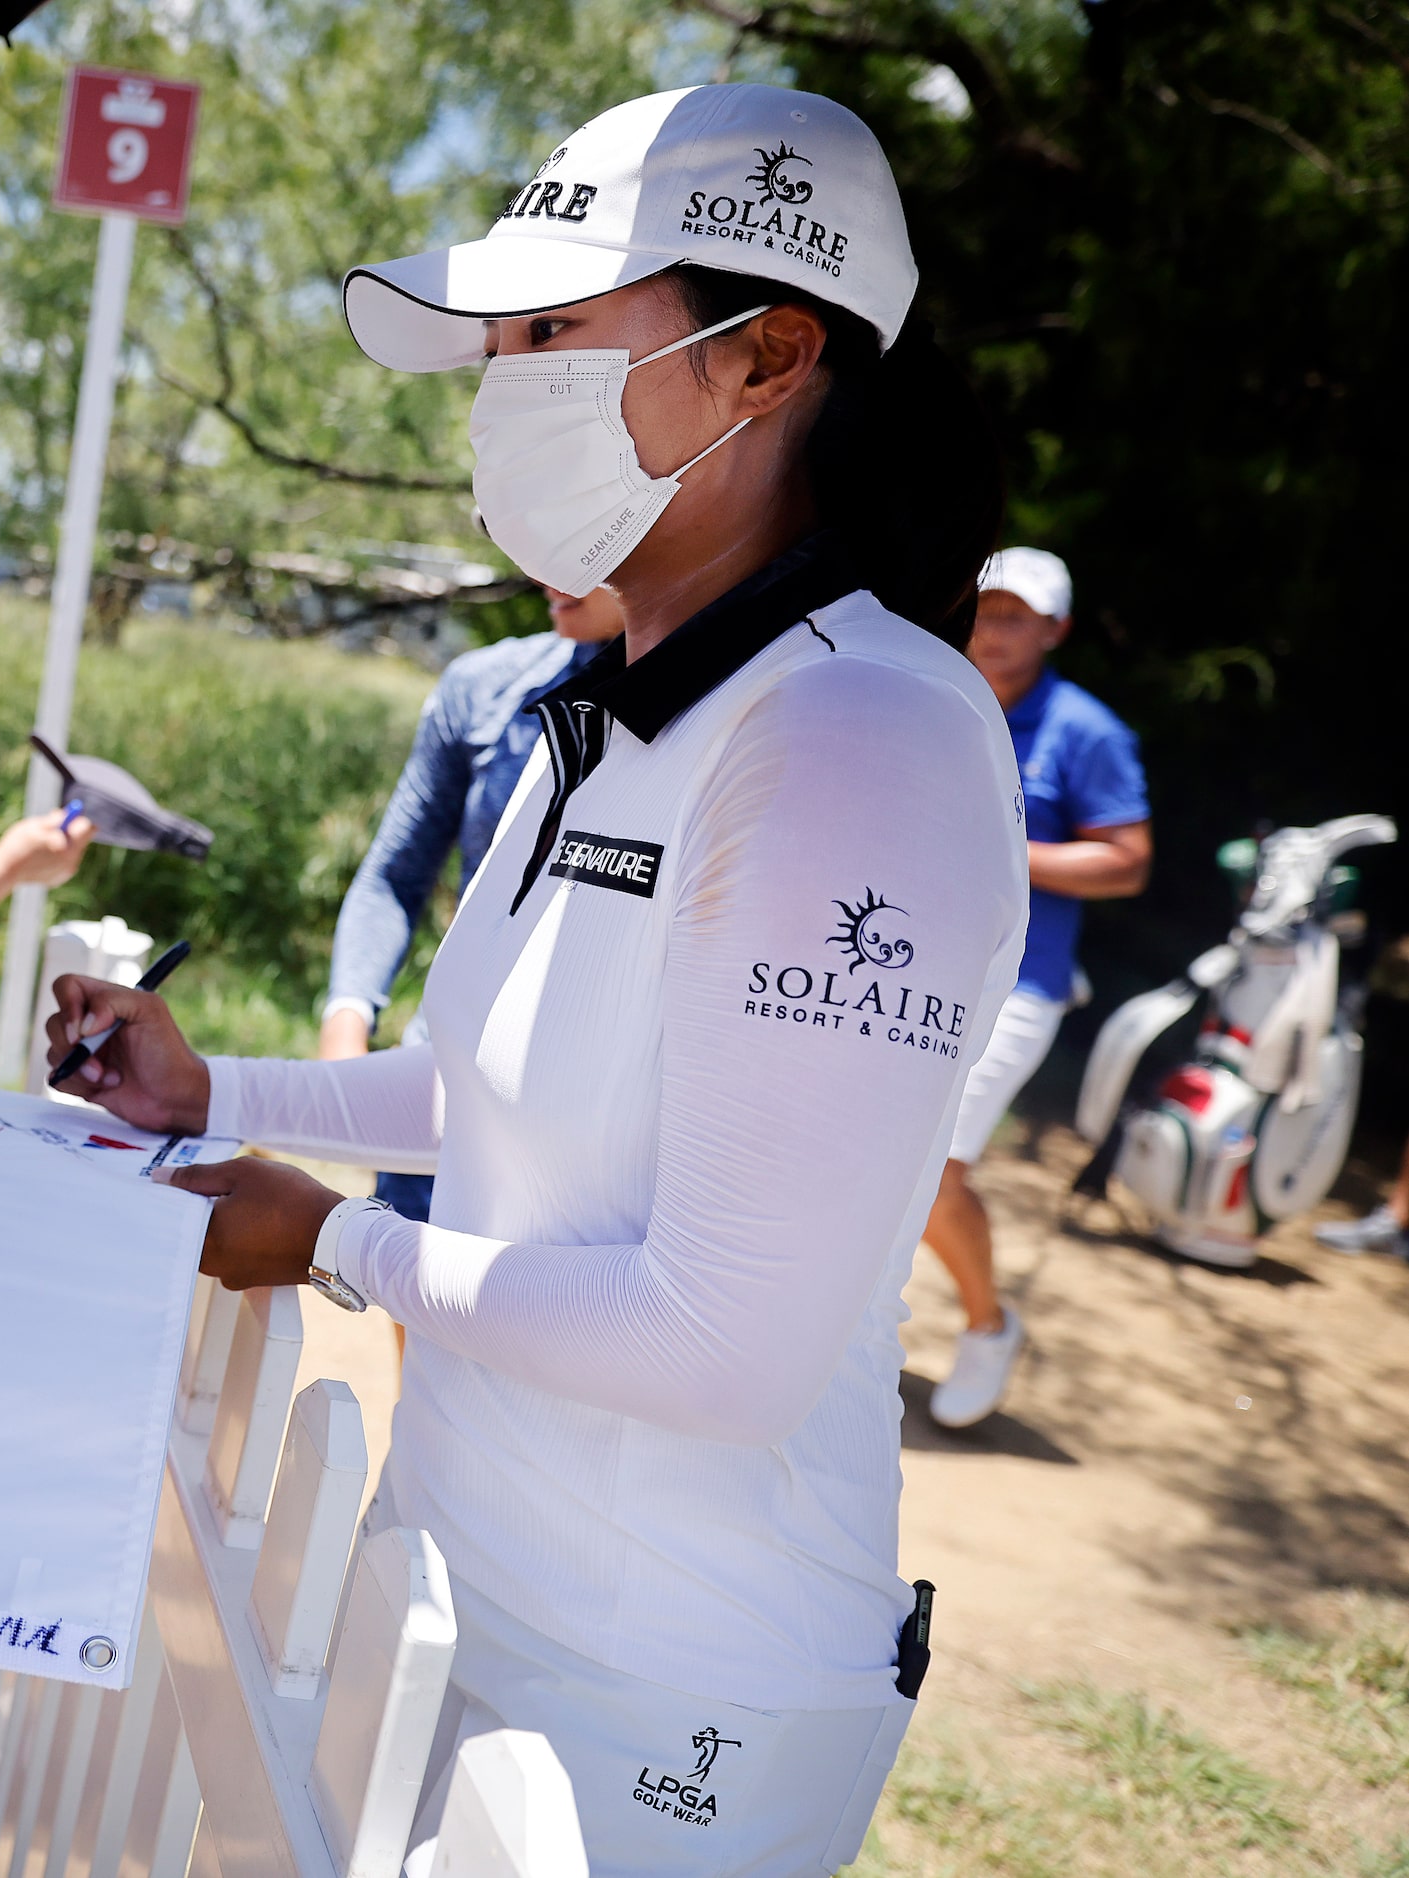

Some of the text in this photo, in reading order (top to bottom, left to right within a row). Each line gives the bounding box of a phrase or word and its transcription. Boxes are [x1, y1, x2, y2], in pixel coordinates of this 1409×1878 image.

[107, 127, 149, 185] 9
[681, 219, 842, 278] RESORT & CASINO
[684, 191, 849, 263] SOLAIRE
[549, 383, 573, 395] OUT
[580, 507, 636, 567] CLEAN & SAFE
[559, 840, 655, 884] SIGNATURE
[747, 962, 966, 1039] SOLAIRE
[744, 1000, 960, 1061] RESORT & CASINO
[632, 1788, 712, 1828] GOLF WEAR
[637, 1767, 717, 1817] LPGA
